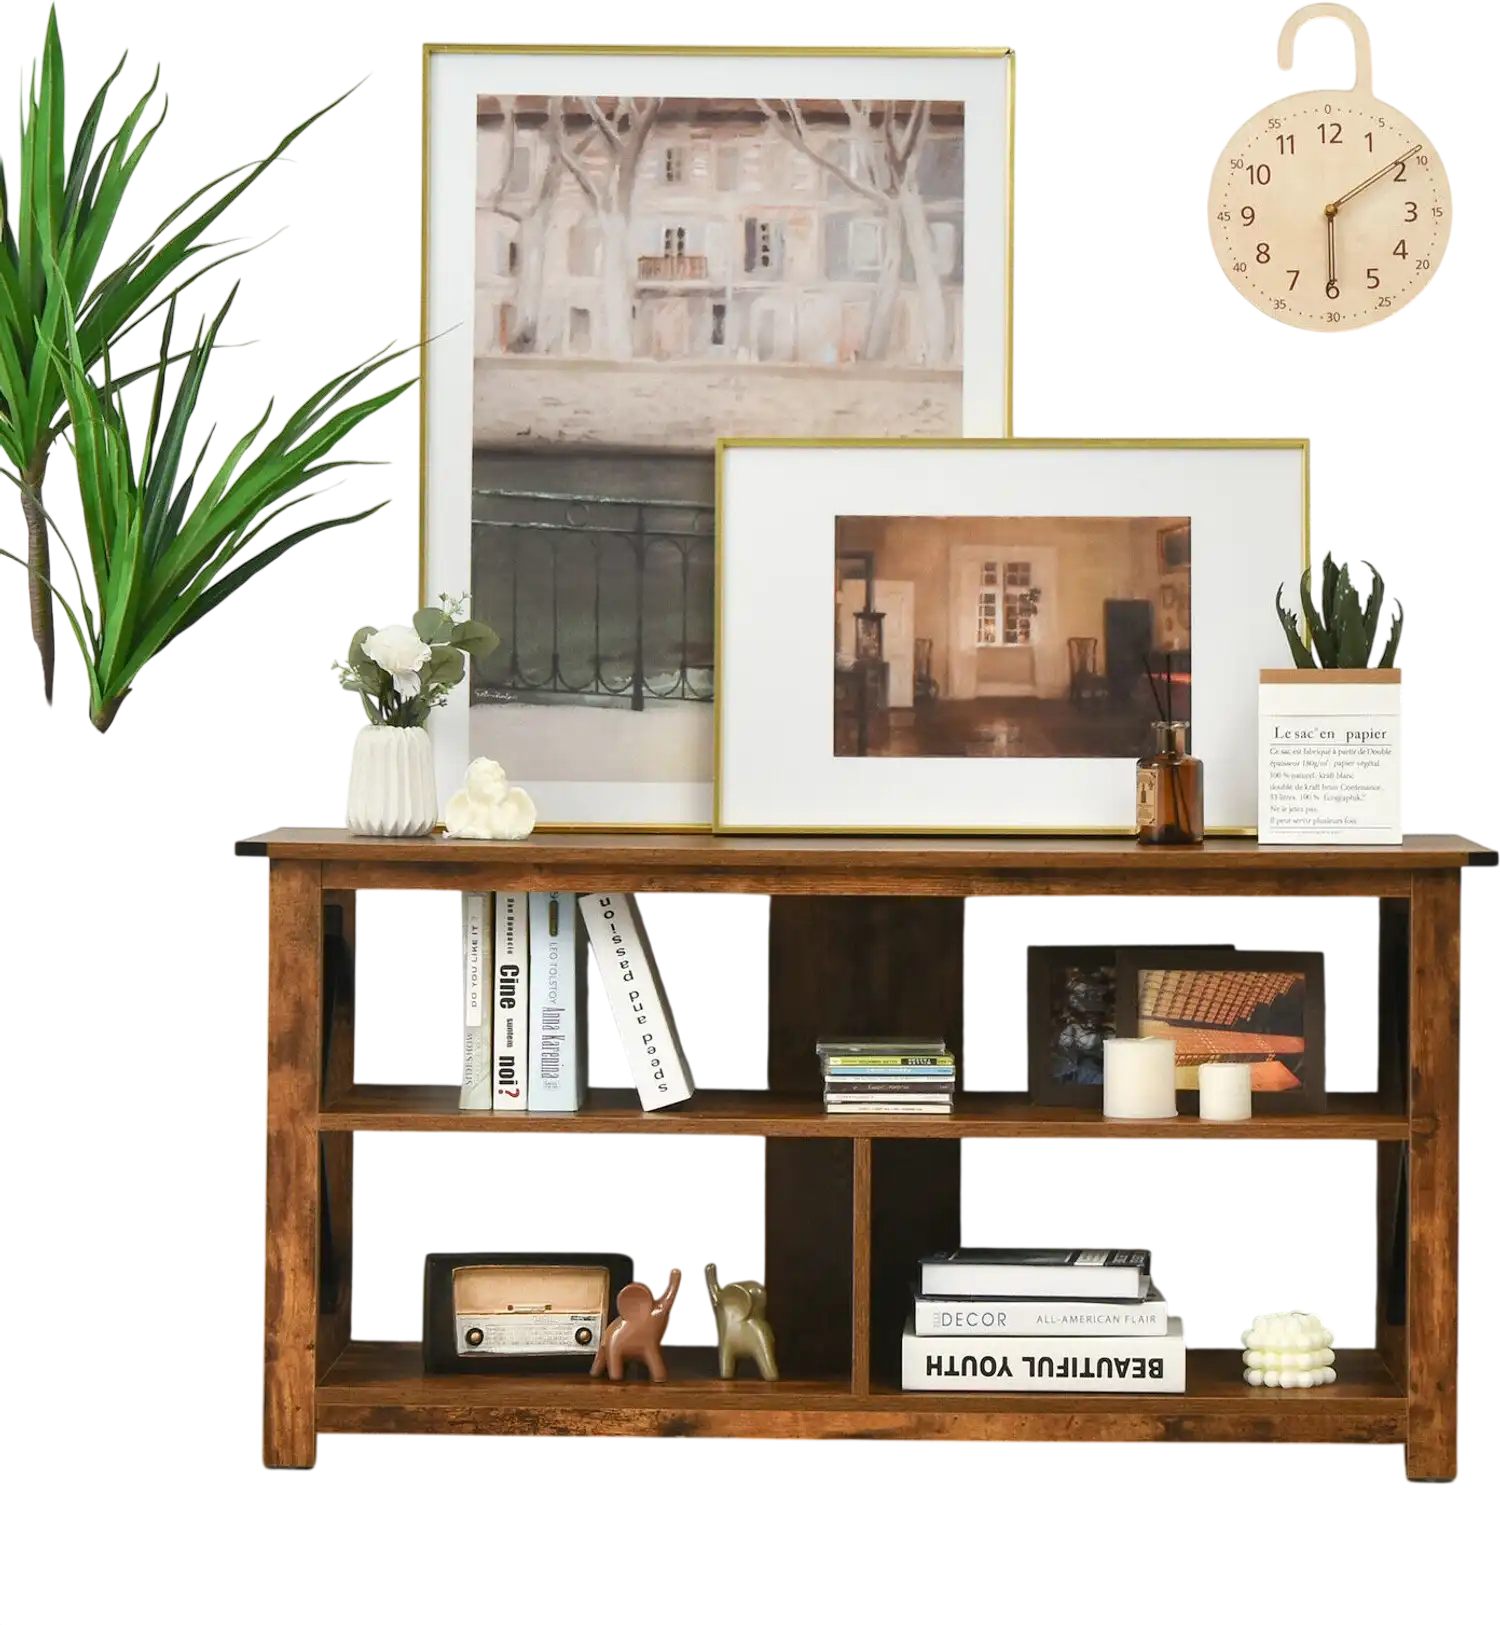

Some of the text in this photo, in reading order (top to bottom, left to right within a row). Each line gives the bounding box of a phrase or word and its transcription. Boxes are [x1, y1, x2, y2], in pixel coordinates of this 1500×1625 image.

[1324, 104, 1331, 114] 0
[1268, 119, 1281, 128] 55
[1378, 118, 1385, 127] 5
[1317, 123, 1343, 144] 12
[1364, 132, 1372, 152] 1
[1276, 134, 1295, 155] 11
[1230, 159, 1244, 169] 50
[1416, 156, 1428, 166] 10
[1246, 164, 1271, 185] 10
[1393, 161, 1407, 182] 2
[1217, 212, 1231, 221] 45
[1241, 206, 1255, 226] 9
[1404, 201, 1418, 223] 3
[1432, 208, 1443, 217] 15
[1256, 243, 1271, 264] 8
[1392, 239, 1409, 260] 4
[1233, 263, 1247, 272] 40
[1416, 260, 1429, 270] 20
[1286, 270, 1300, 291] 7
[1325, 278, 1340, 299] 6
[1366, 268, 1380, 289] 5
[1273, 300, 1287, 309] 35
[1378, 297, 1392, 307] 25
[1327, 312, 1341, 322] 30
[1274, 726, 1292, 739] Le
[1320, 731, 1335, 739] en
[1346, 728, 1387, 743] papier
[472, 924, 479, 935] IT
[549, 943, 558, 1005] LEO TOLSTOY
[500, 964, 520, 1009] Cine
[600, 898, 668, 1093] speed and passion
[472, 992, 477, 1008] DO
[542, 1007, 566, 1032] Anna
[541, 1035, 565, 1079] Karenina
[498, 1055, 520, 1098] noi?
[941, 1312, 1007, 1327] DECOR
[1036, 1315, 1156, 1325] ALL-AMERICAN FLAIR
[925, 1355, 1164, 1379] BEAUTIFUL YOUTH
